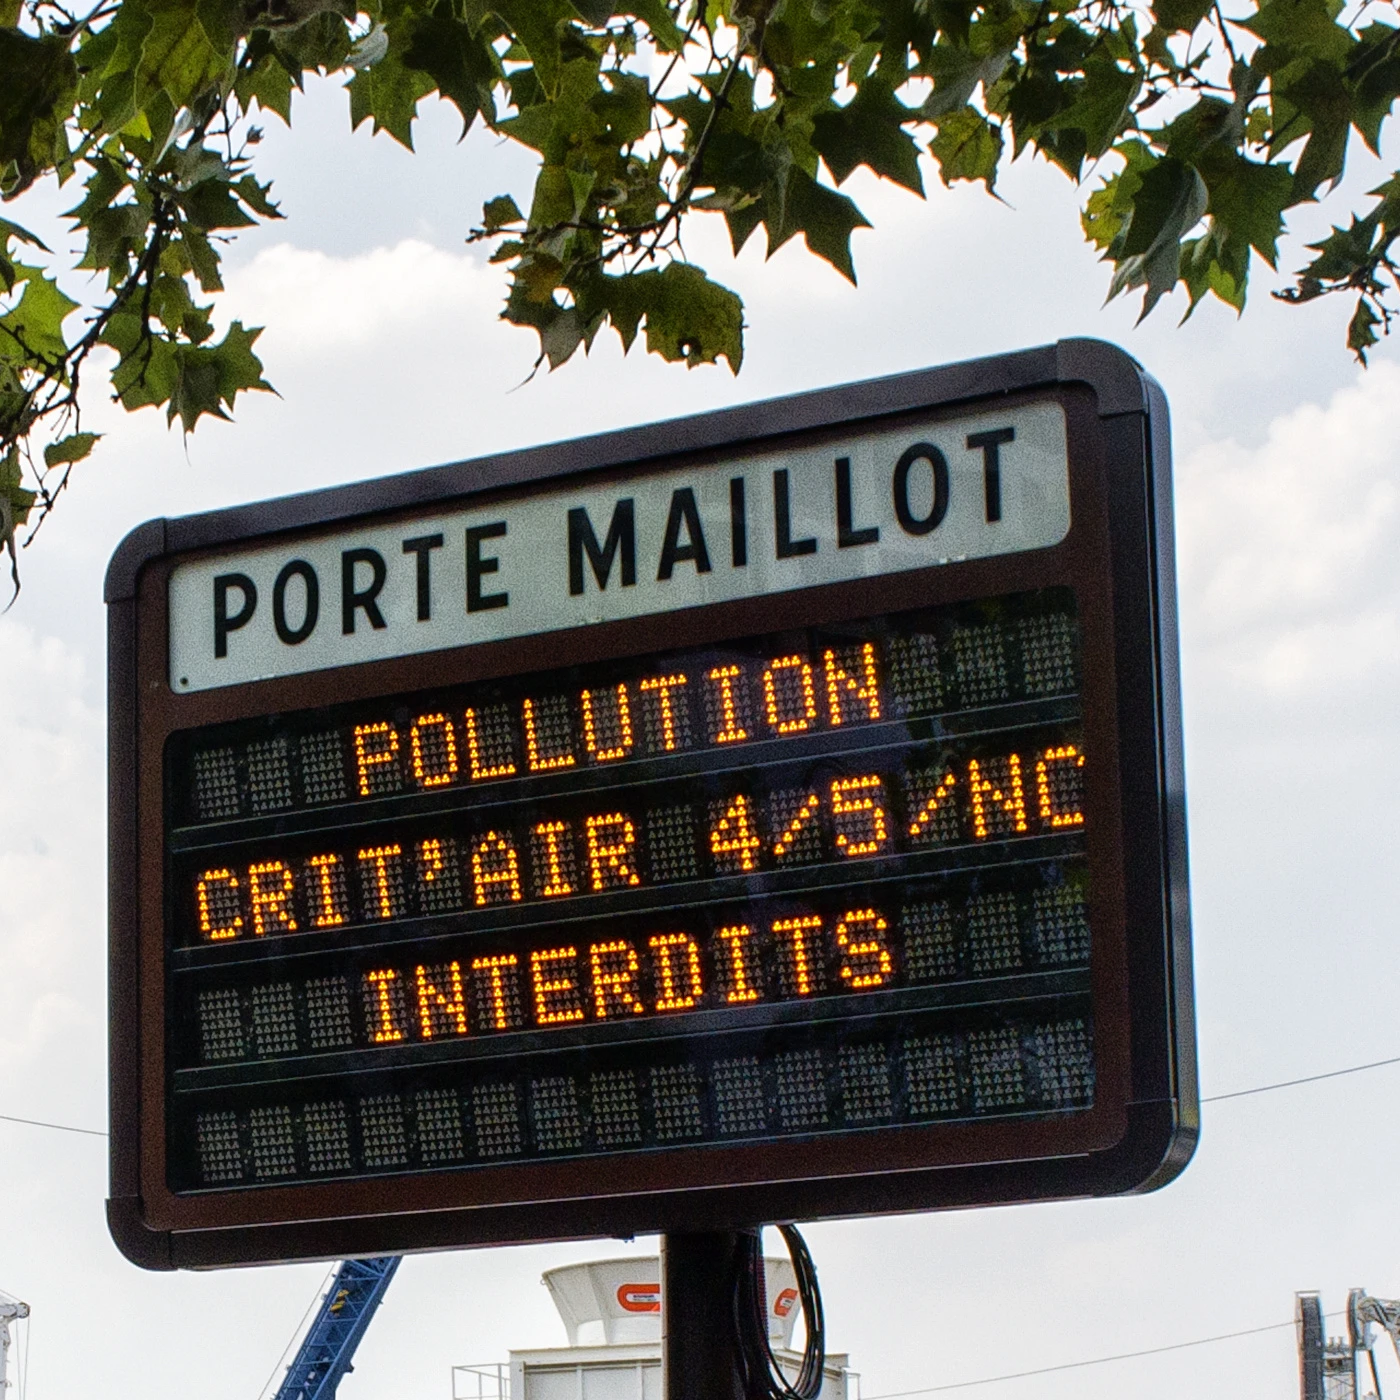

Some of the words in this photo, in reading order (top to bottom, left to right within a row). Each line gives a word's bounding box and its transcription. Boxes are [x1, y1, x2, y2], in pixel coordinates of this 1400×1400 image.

[213, 521, 510, 658] PORTE
[567, 427, 1016, 597] MAILLOT
[354, 642, 884, 796] POLLUTION
[197, 811, 640, 940] CRIT'AIR
[710, 744, 1085, 871] 4/5/NC
[366, 908, 892, 1042] INTERDITS
